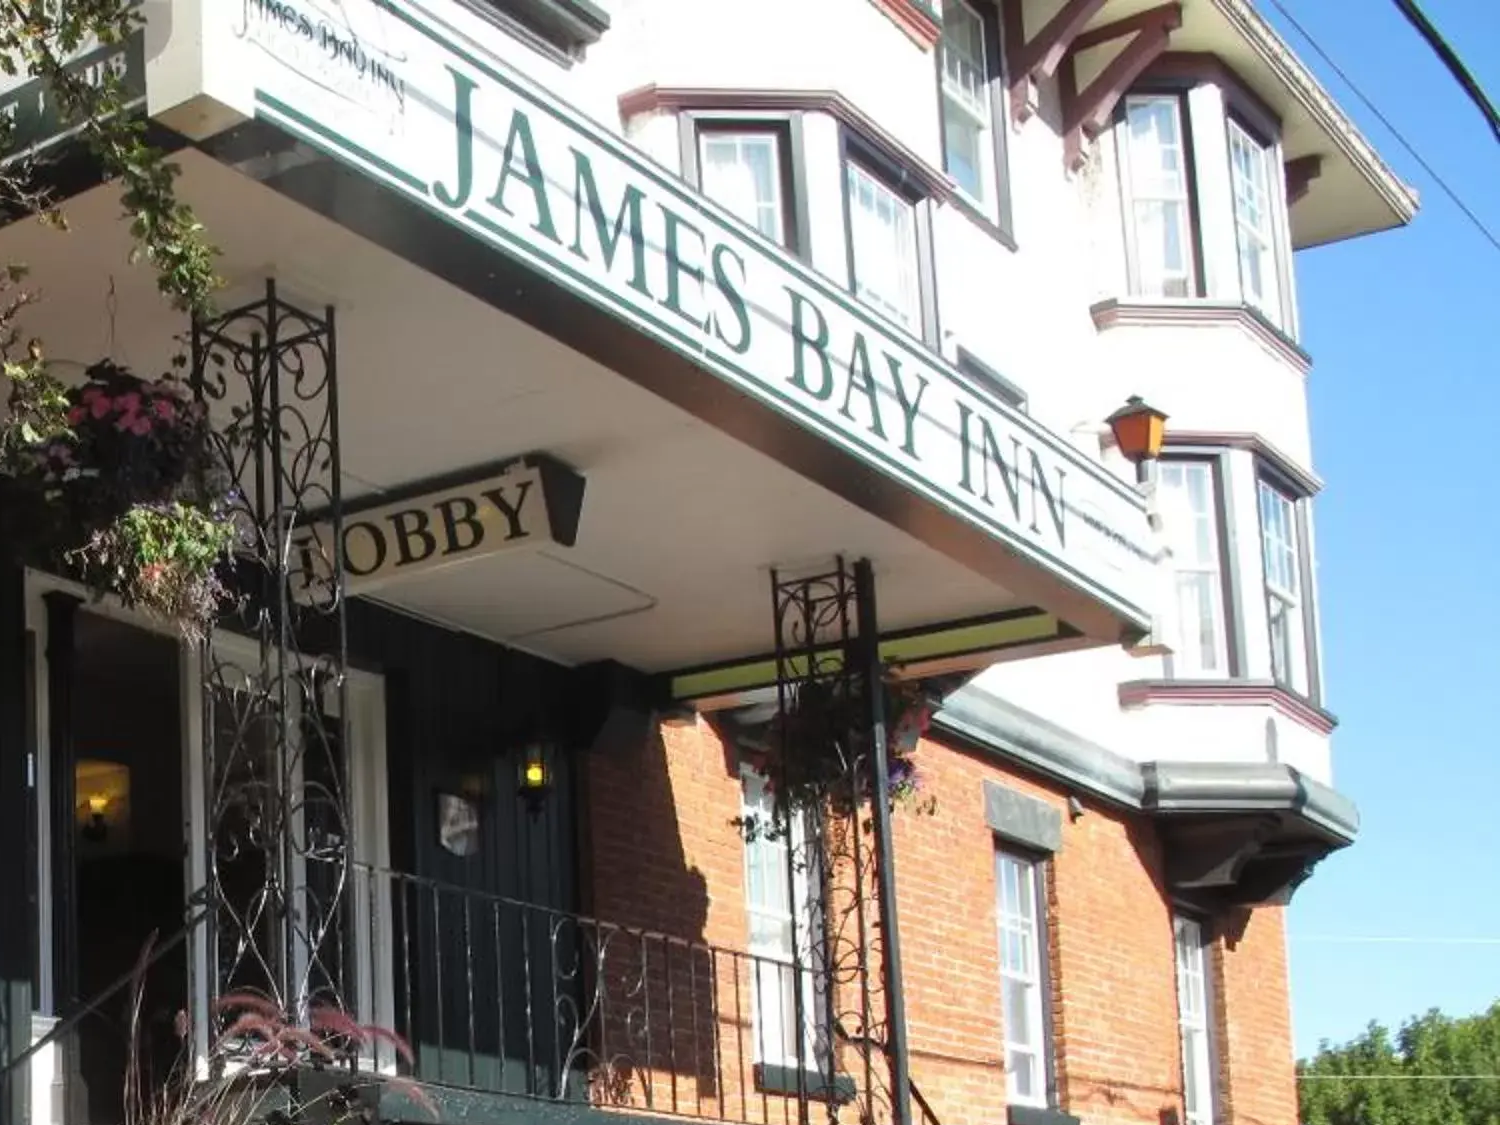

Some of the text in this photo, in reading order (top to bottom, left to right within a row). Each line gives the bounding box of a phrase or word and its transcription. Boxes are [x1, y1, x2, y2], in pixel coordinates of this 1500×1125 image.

[432, 63, 1068, 552] JAMES BAY INN
[292, 480, 534, 590] LOBBY
